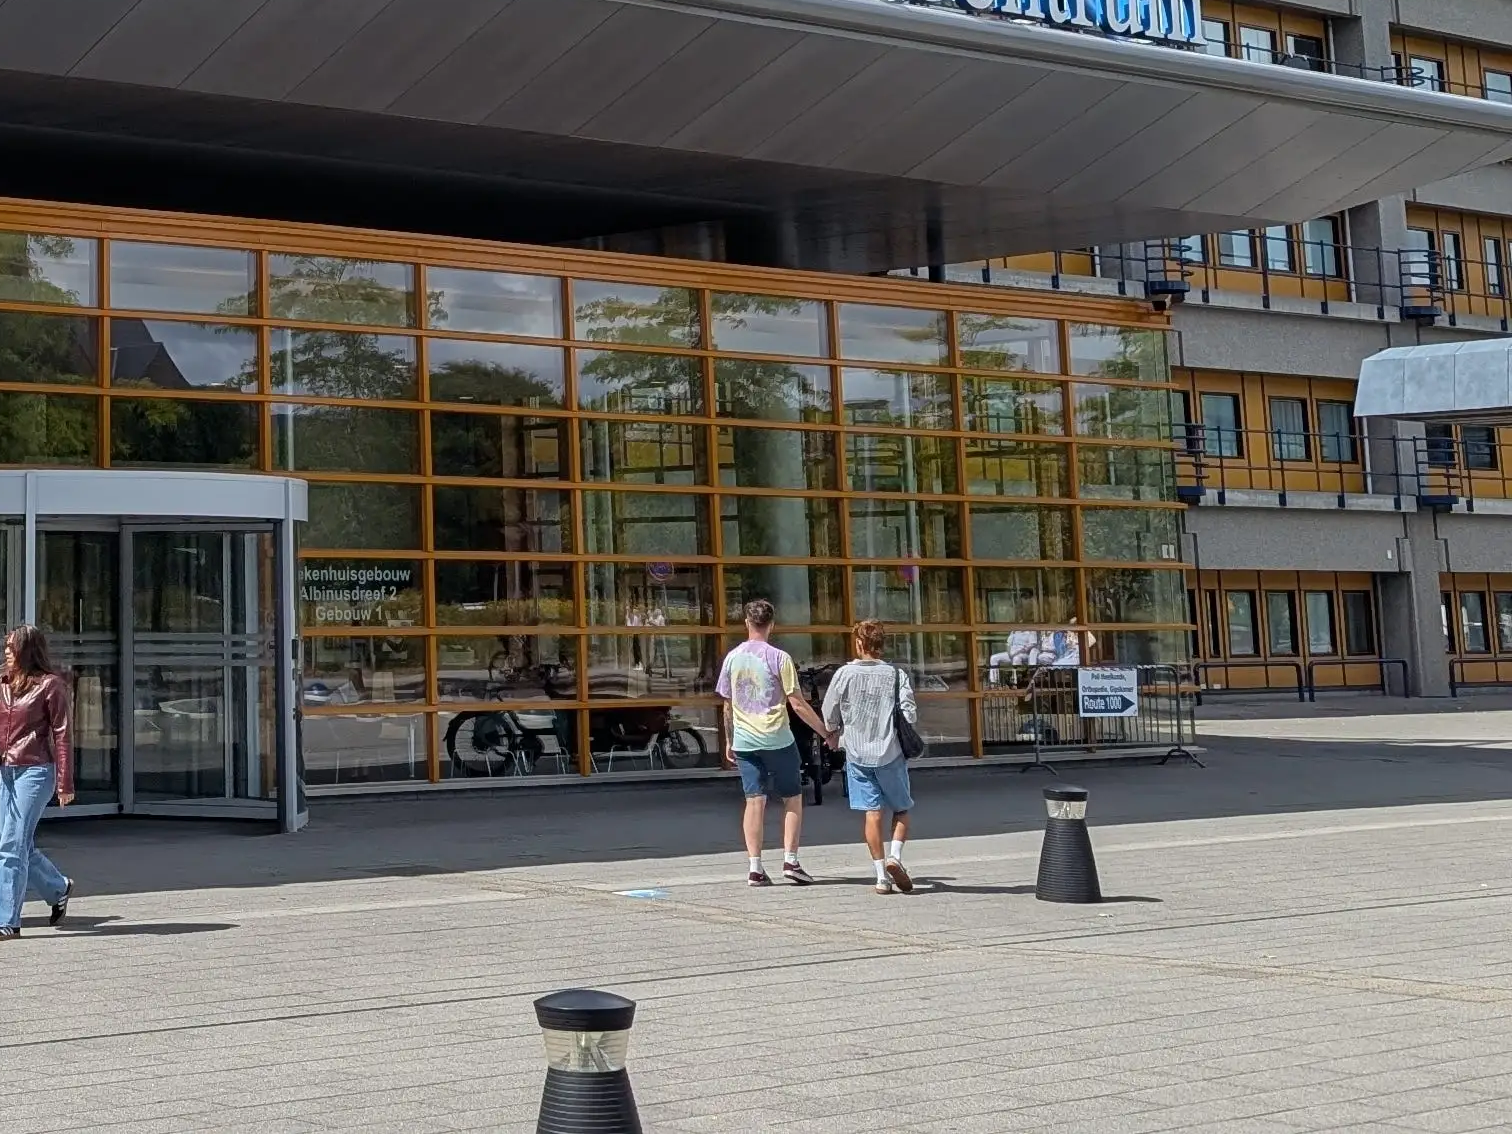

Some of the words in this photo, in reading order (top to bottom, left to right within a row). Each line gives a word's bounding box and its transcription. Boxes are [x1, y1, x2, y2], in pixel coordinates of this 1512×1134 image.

[300, 586, 386, 601] Albinusdreef
[389, 586, 397, 601] 2
[315, 606, 372, 621] Gebouw
[375, 605, 382, 621] 1
[1084, 696, 1105, 710] Route
[1106, 696, 1122, 710] 1000
